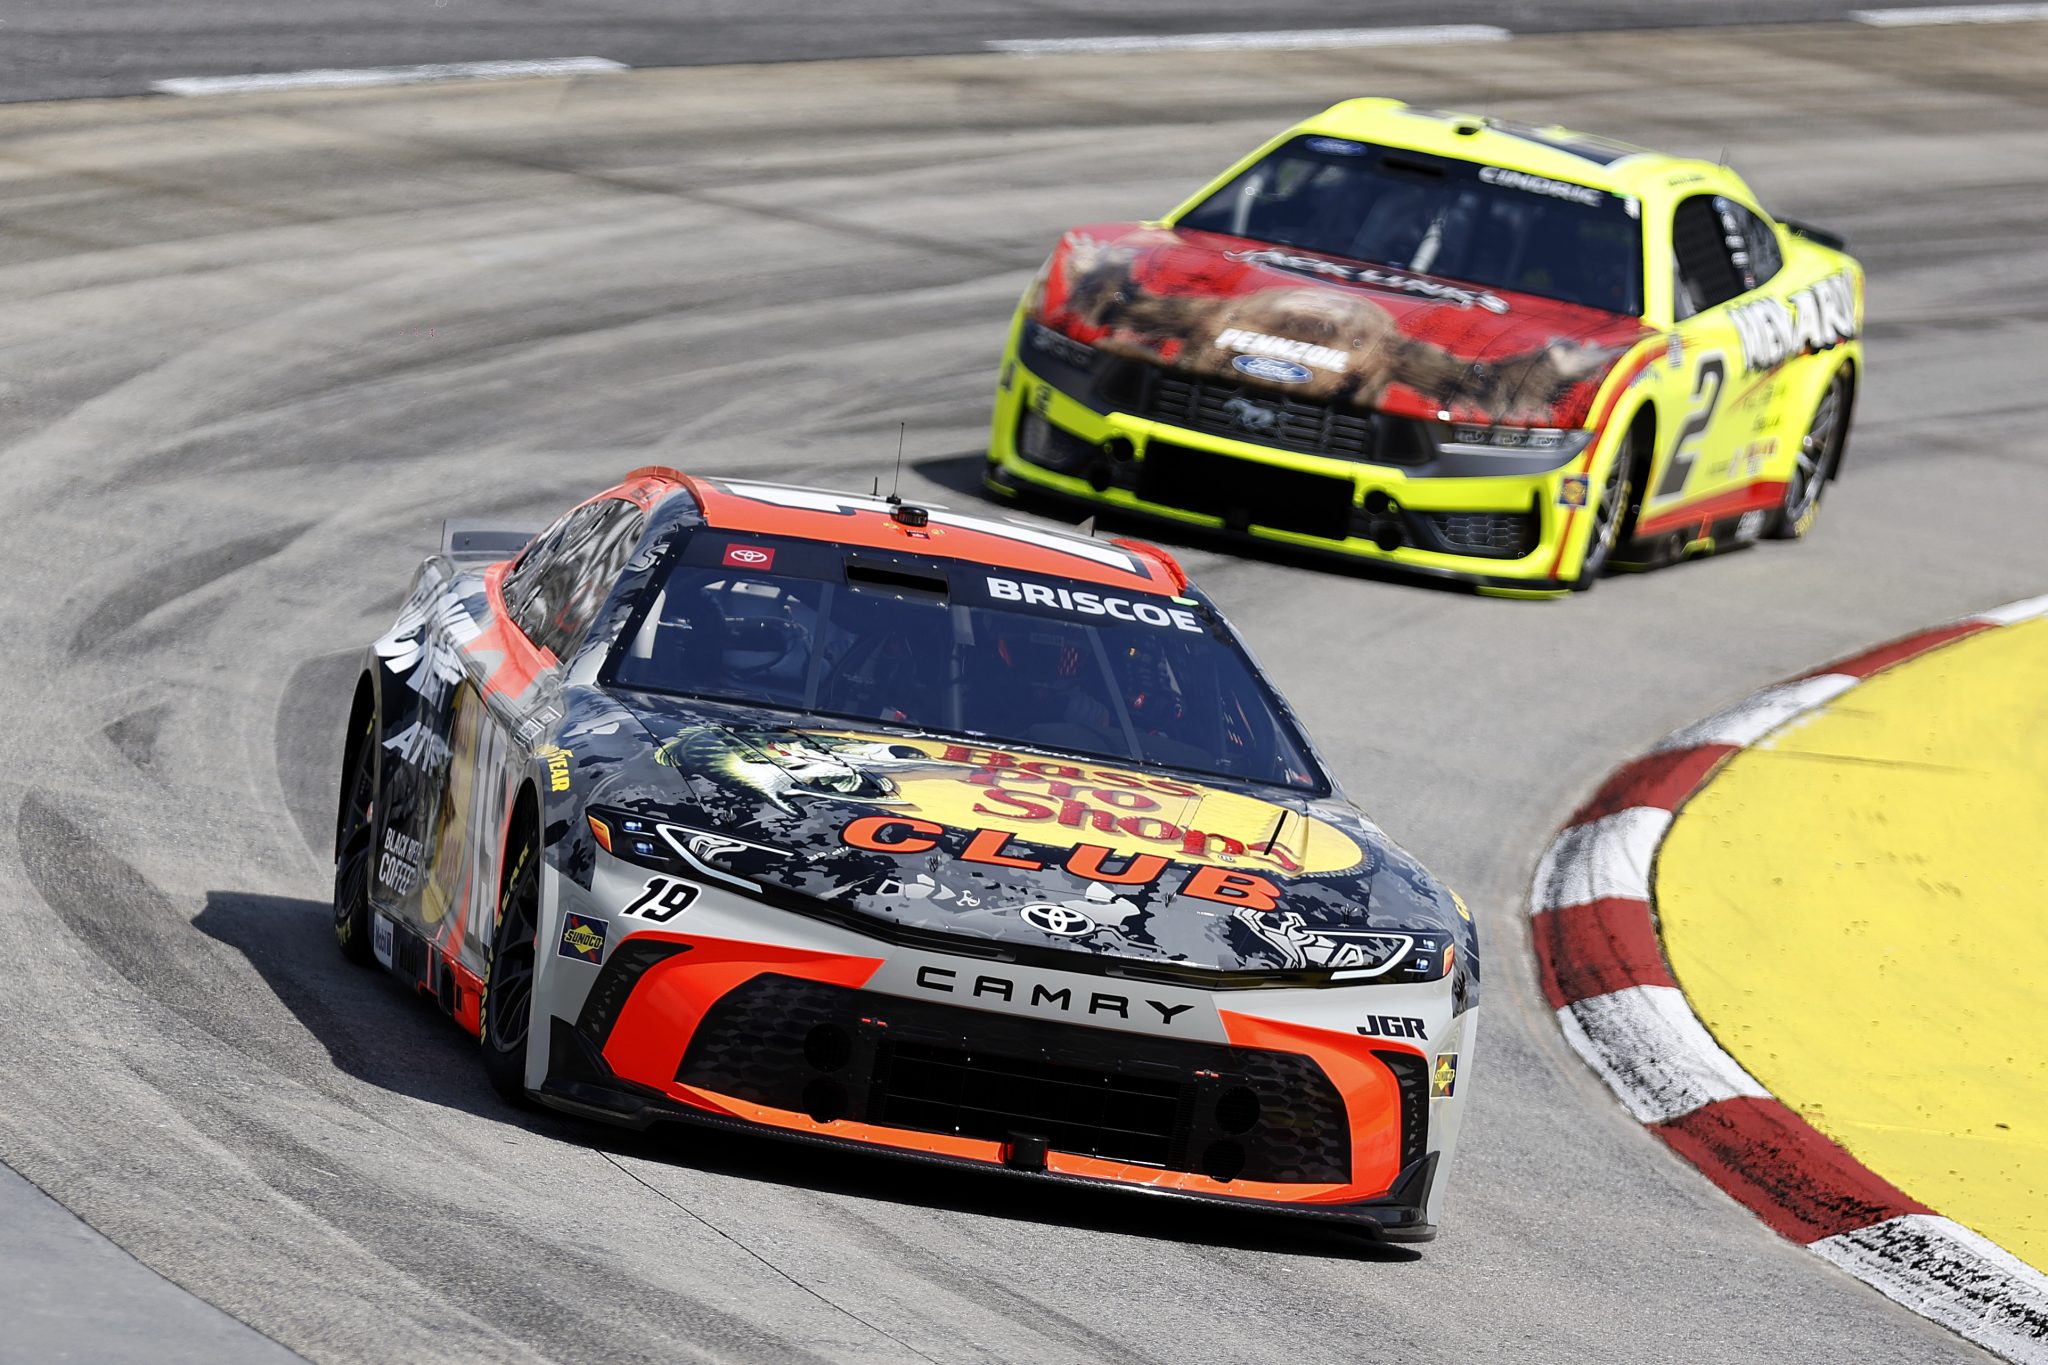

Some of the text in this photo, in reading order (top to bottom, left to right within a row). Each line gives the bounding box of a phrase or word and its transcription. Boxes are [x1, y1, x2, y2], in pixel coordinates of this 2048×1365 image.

[1478, 165, 1604, 207] CINDRIC
[1655, 354, 1726, 500] 2
[986, 576, 1204, 634] BRISCOE
[940, 744, 1201, 797] Bass
[962, 765, 1161, 811] Pro
[384, 827, 410, 858] BLACK
[841, 815, 1282, 911] CLUB
[379, 852, 416, 896] COFFEE
[621, 876, 701, 924] 19
[565, 930, 602, 949] SUNOCO
[916, 965, 1196, 1025] CAMRY
[1356, 1014, 1429, 1041] JGR
